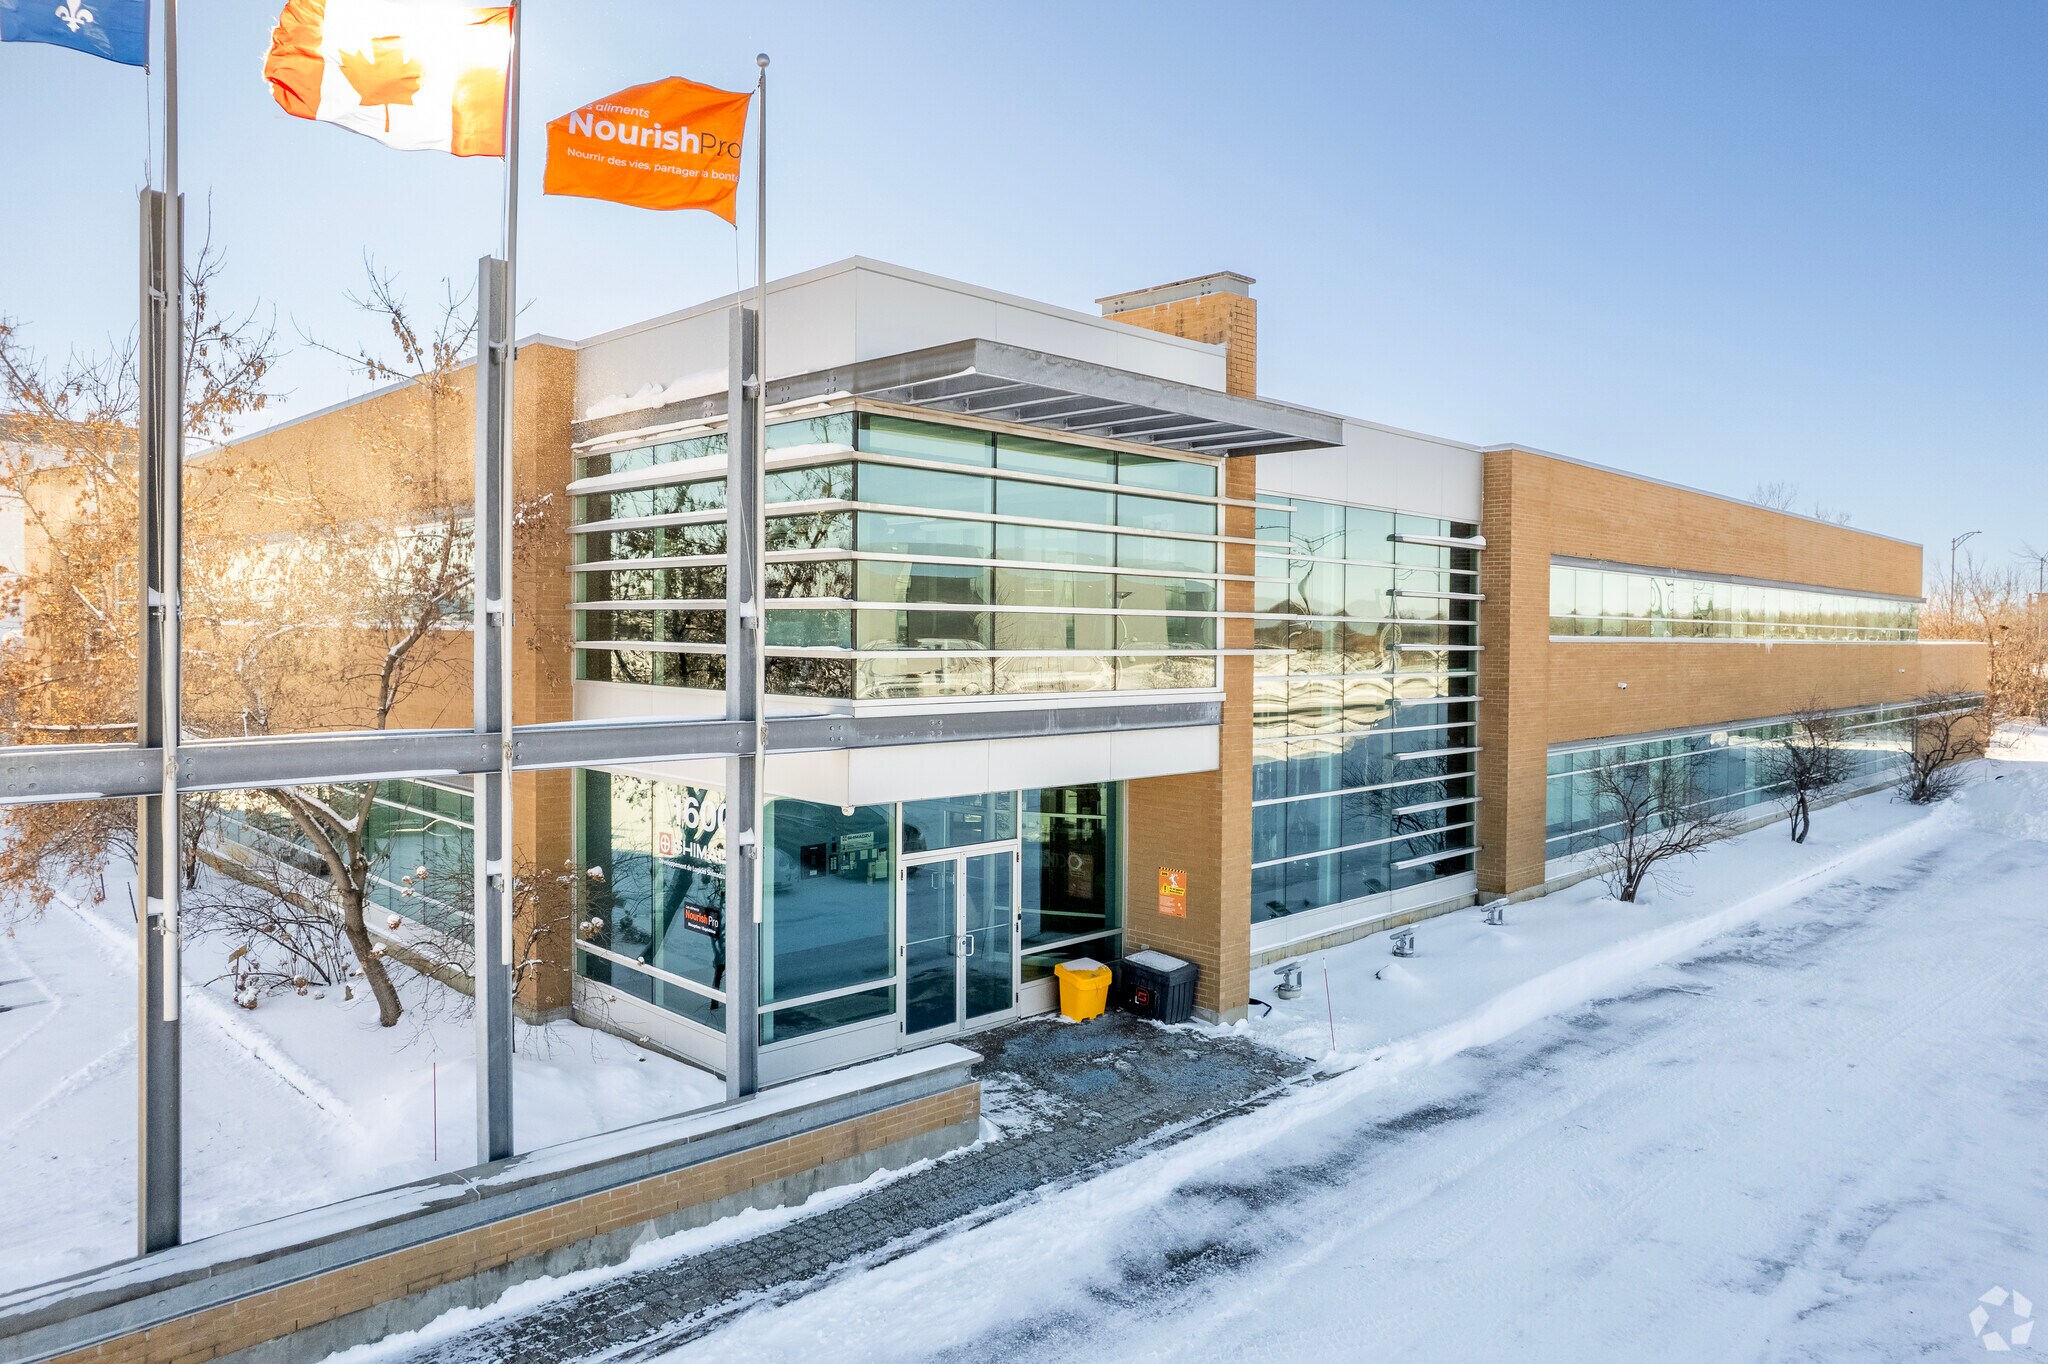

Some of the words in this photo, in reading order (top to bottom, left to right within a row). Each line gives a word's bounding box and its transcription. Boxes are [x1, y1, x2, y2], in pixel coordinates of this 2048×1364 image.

[595, 102, 650, 119] aliments
[567, 147, 606, 162] Nourrir
[607, 156, 627, 167] des
[629, 159, 652, 171] vies,
[654, 163, 700, 178] partager
